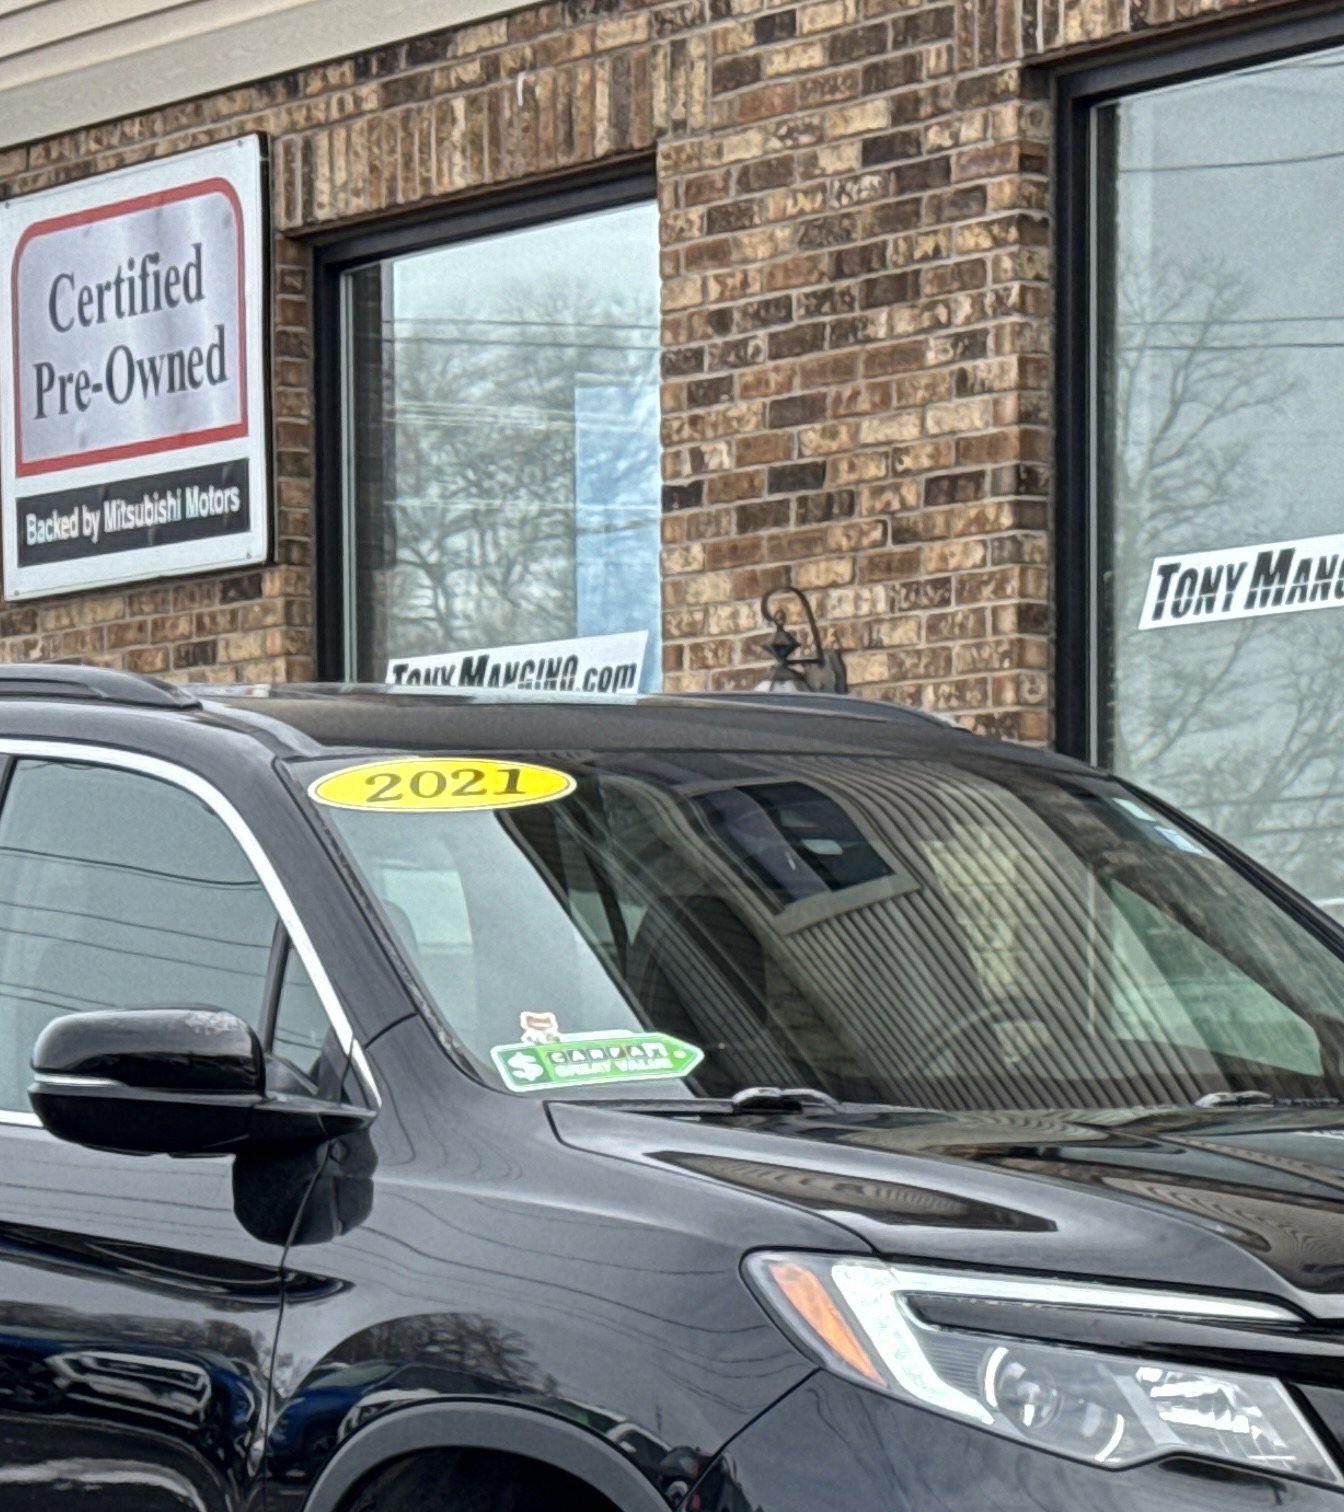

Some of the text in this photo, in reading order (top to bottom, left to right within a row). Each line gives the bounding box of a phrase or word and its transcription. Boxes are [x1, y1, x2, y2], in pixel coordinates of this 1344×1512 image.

[48, 243, 205, 333] Certified
[33, 325, 228, 420] Pre-Owned
[25, 485, 241, 546] Backed by Mitsubishi Motors
[1151, 562, 1248, 622] TONY
[365, 767, 528, 803] 2021
